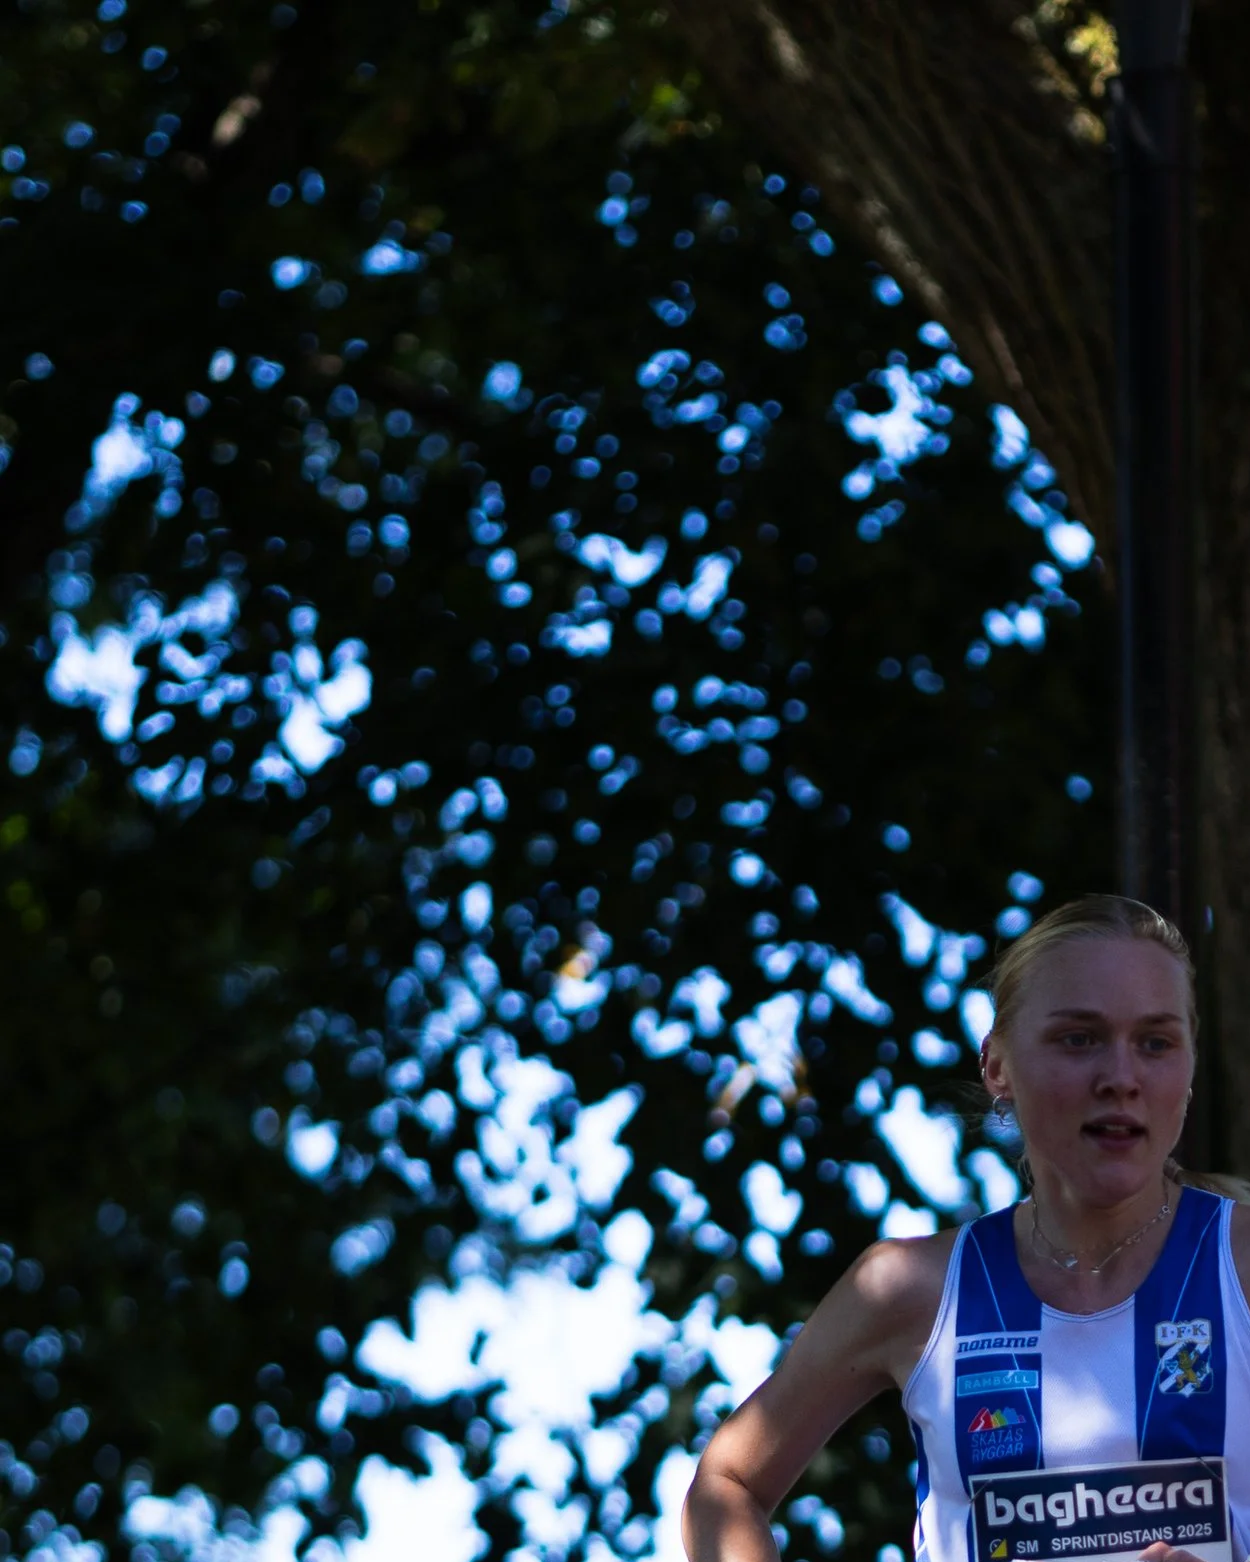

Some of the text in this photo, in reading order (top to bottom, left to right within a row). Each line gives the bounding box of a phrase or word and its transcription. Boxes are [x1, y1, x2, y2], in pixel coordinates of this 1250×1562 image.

[957, 1335, 1039, 1353] noname
[971, 1442, 1024, 1463] RYGGAR
[984, 1478, 1214, 1528] bagheera
[1016, 1522, 1213, 1554] SM SPRINTDISTANS 2025
